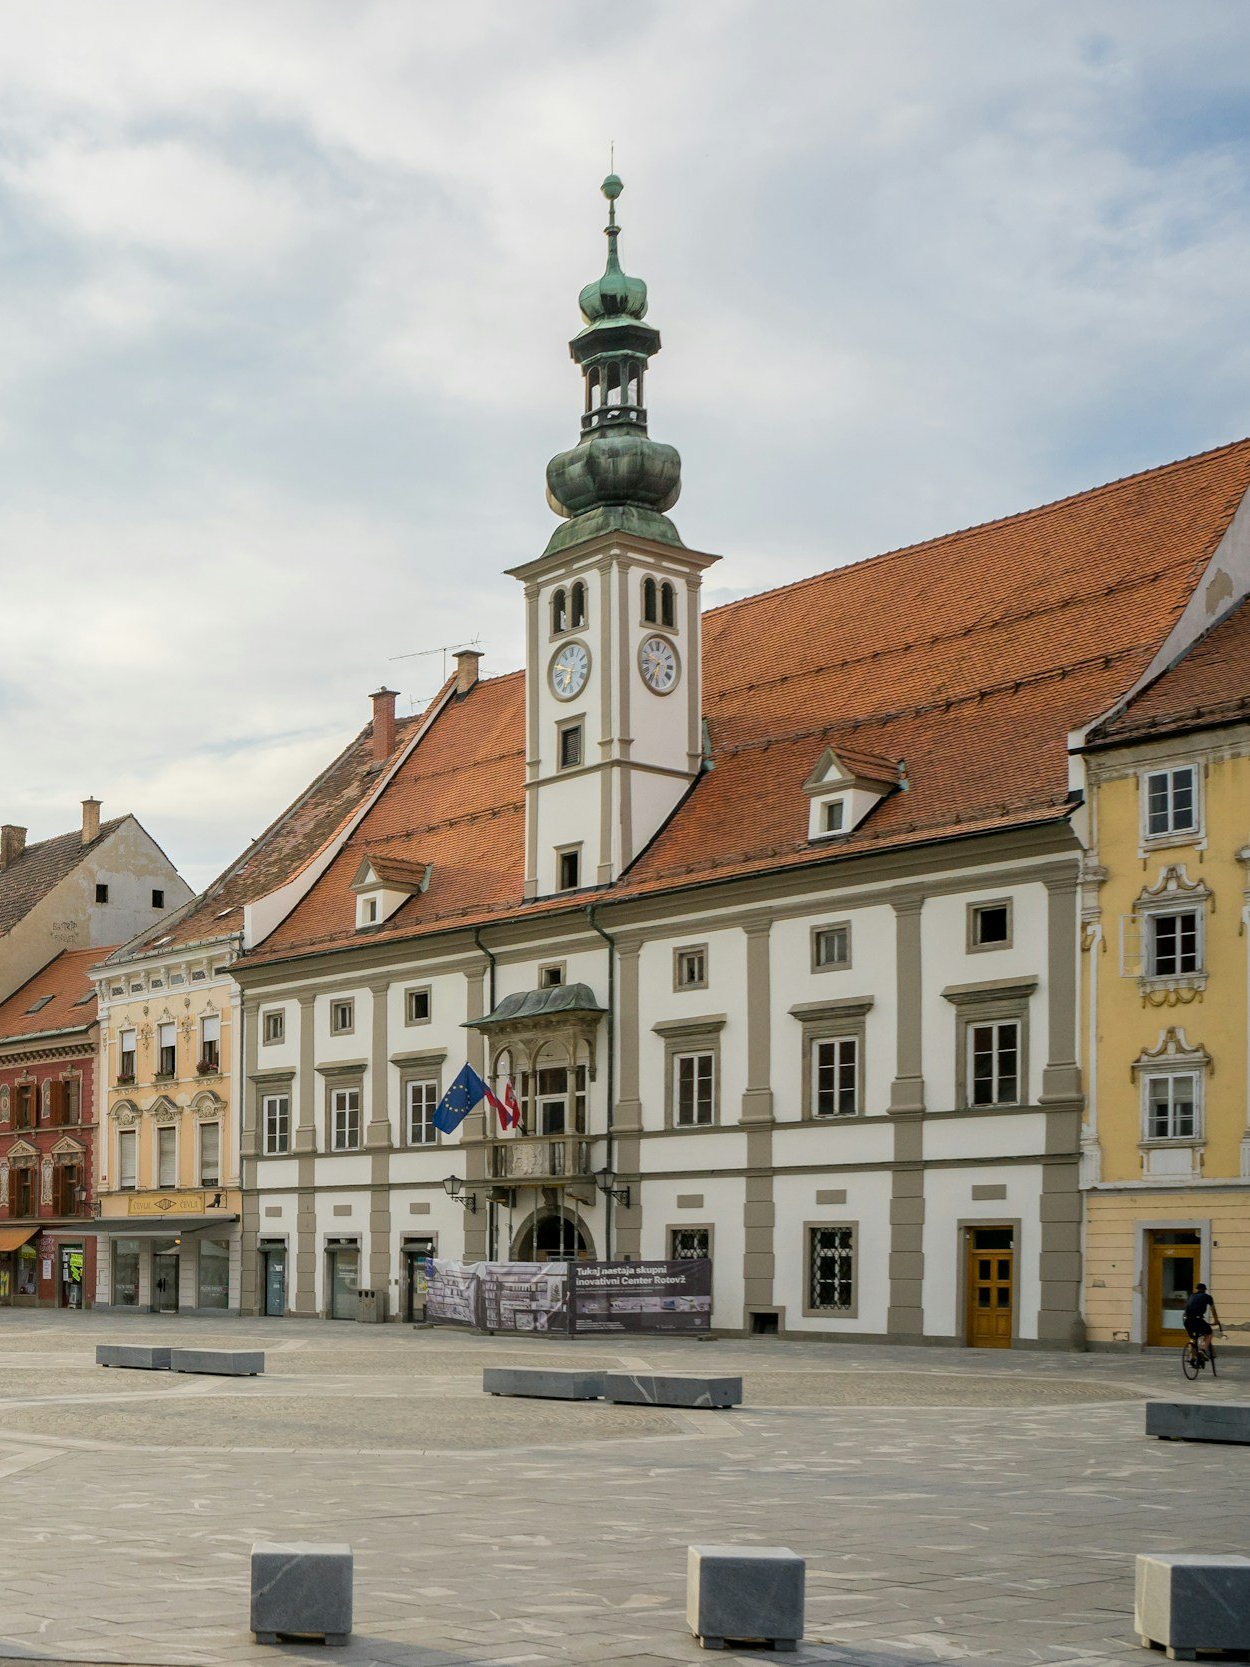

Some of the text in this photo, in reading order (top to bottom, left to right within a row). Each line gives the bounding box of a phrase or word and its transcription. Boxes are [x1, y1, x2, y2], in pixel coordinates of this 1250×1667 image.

[576, 1265, 667, 1276] Tukaj nastaja skupni
[576, 1275, 686, 1286] inovativni Center Rotovž
